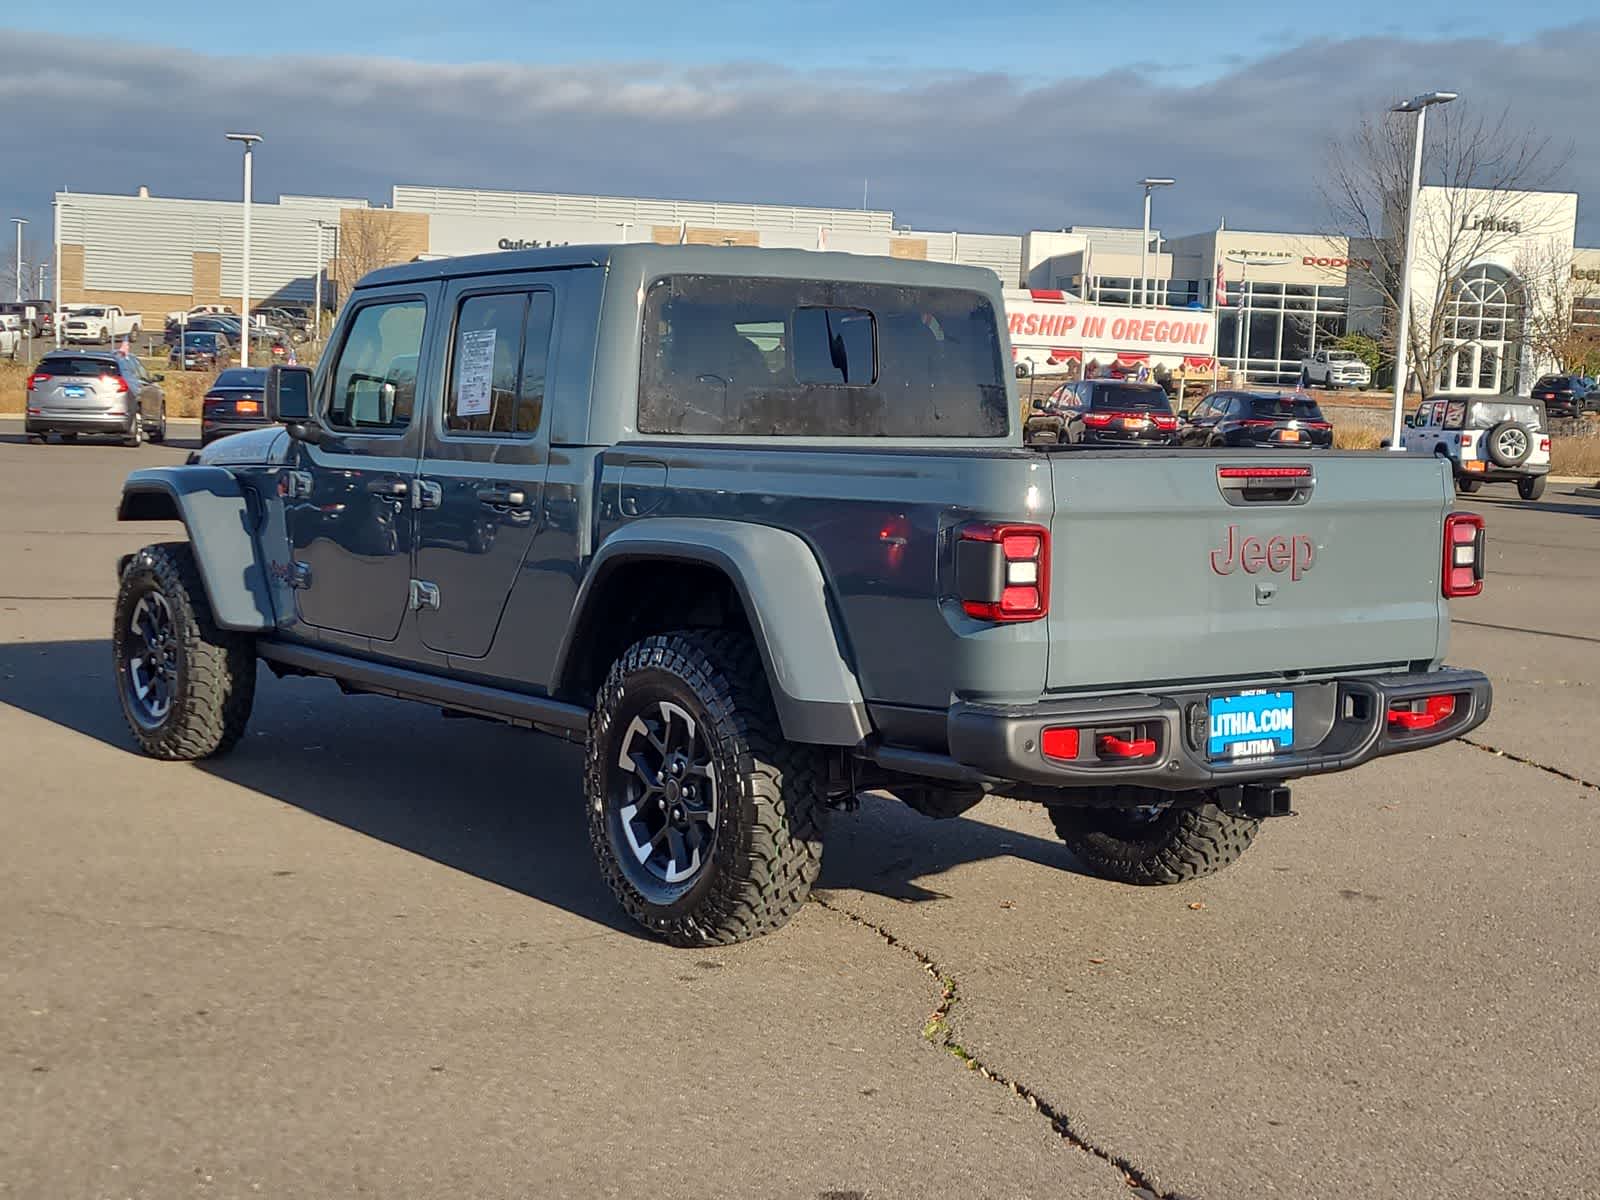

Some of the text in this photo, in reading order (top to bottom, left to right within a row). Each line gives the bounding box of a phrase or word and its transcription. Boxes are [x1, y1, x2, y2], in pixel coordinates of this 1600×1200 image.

[1008, 312, 1209, 345] RSHIP IN OREGON!
[1210, 523, 1313, 582] Jeep
[1211, 707, 1293, 738] LITHIA.COM
